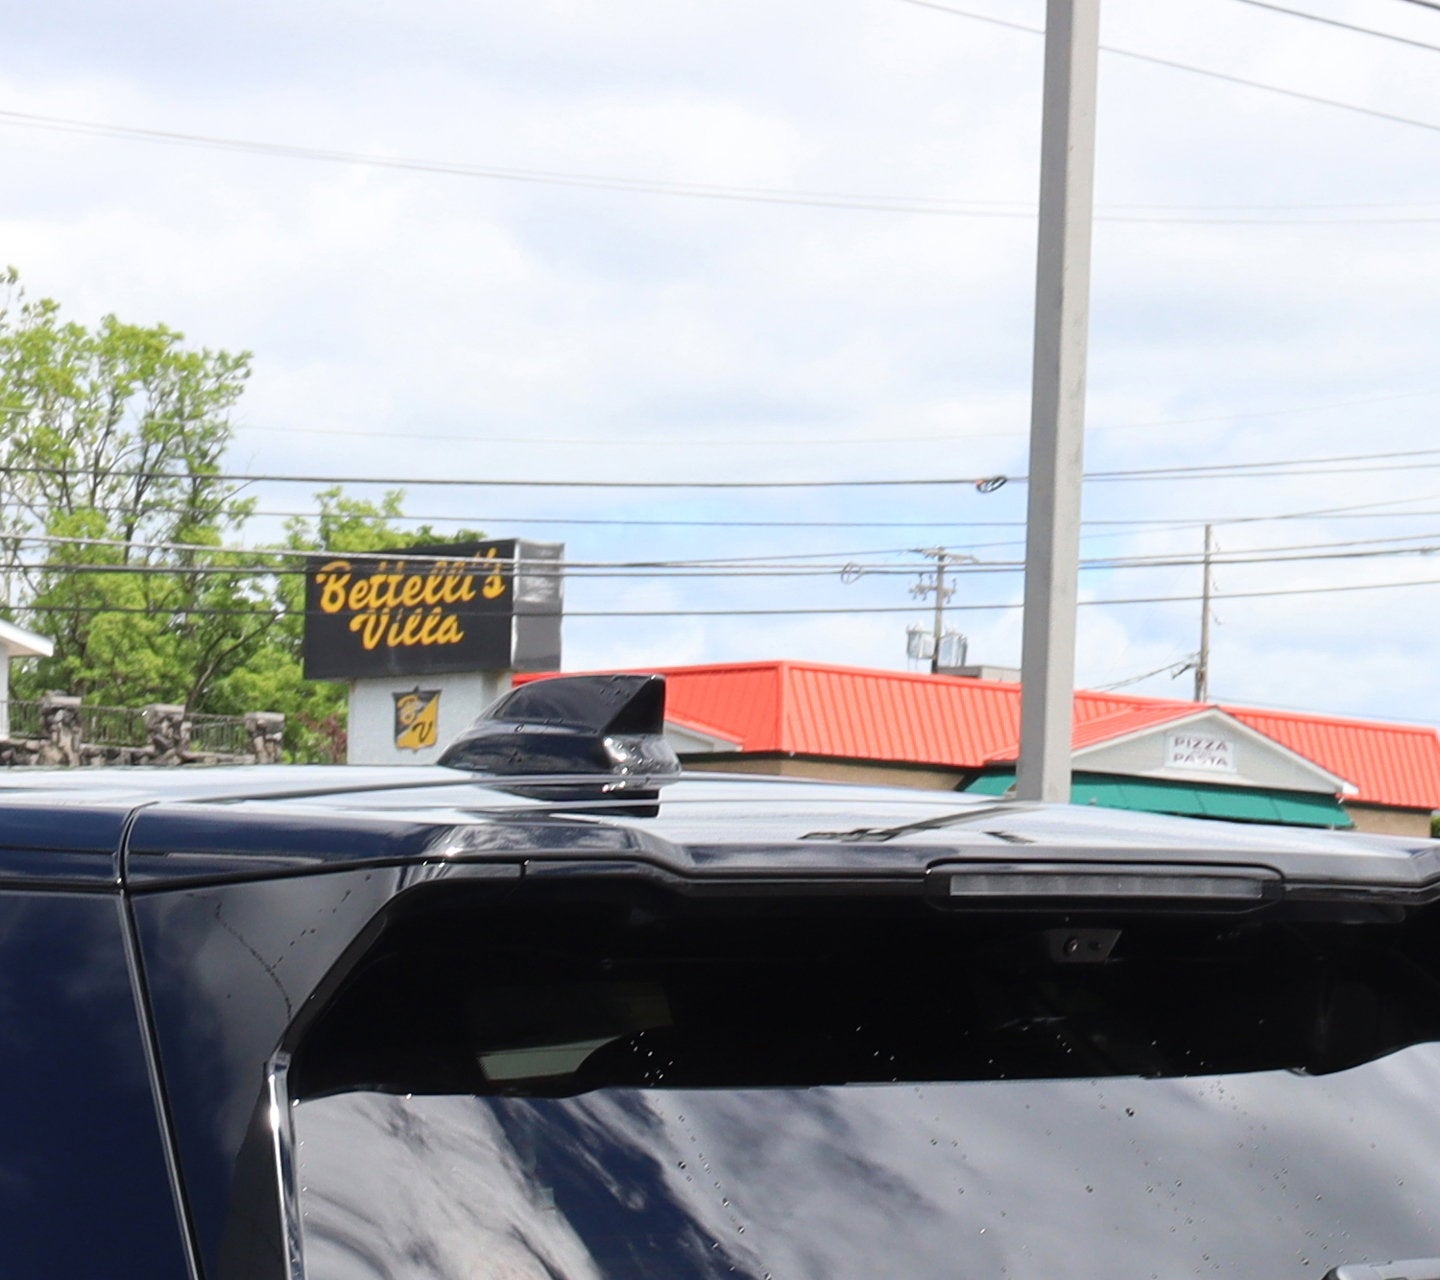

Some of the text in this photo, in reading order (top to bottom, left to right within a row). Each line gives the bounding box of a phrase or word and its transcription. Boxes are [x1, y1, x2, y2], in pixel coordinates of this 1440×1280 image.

[315, 547, 506, 614] Bettelli's
[349, 605, 464, 652] Villa
[1174, 736, 1229, 752] PIZZA
